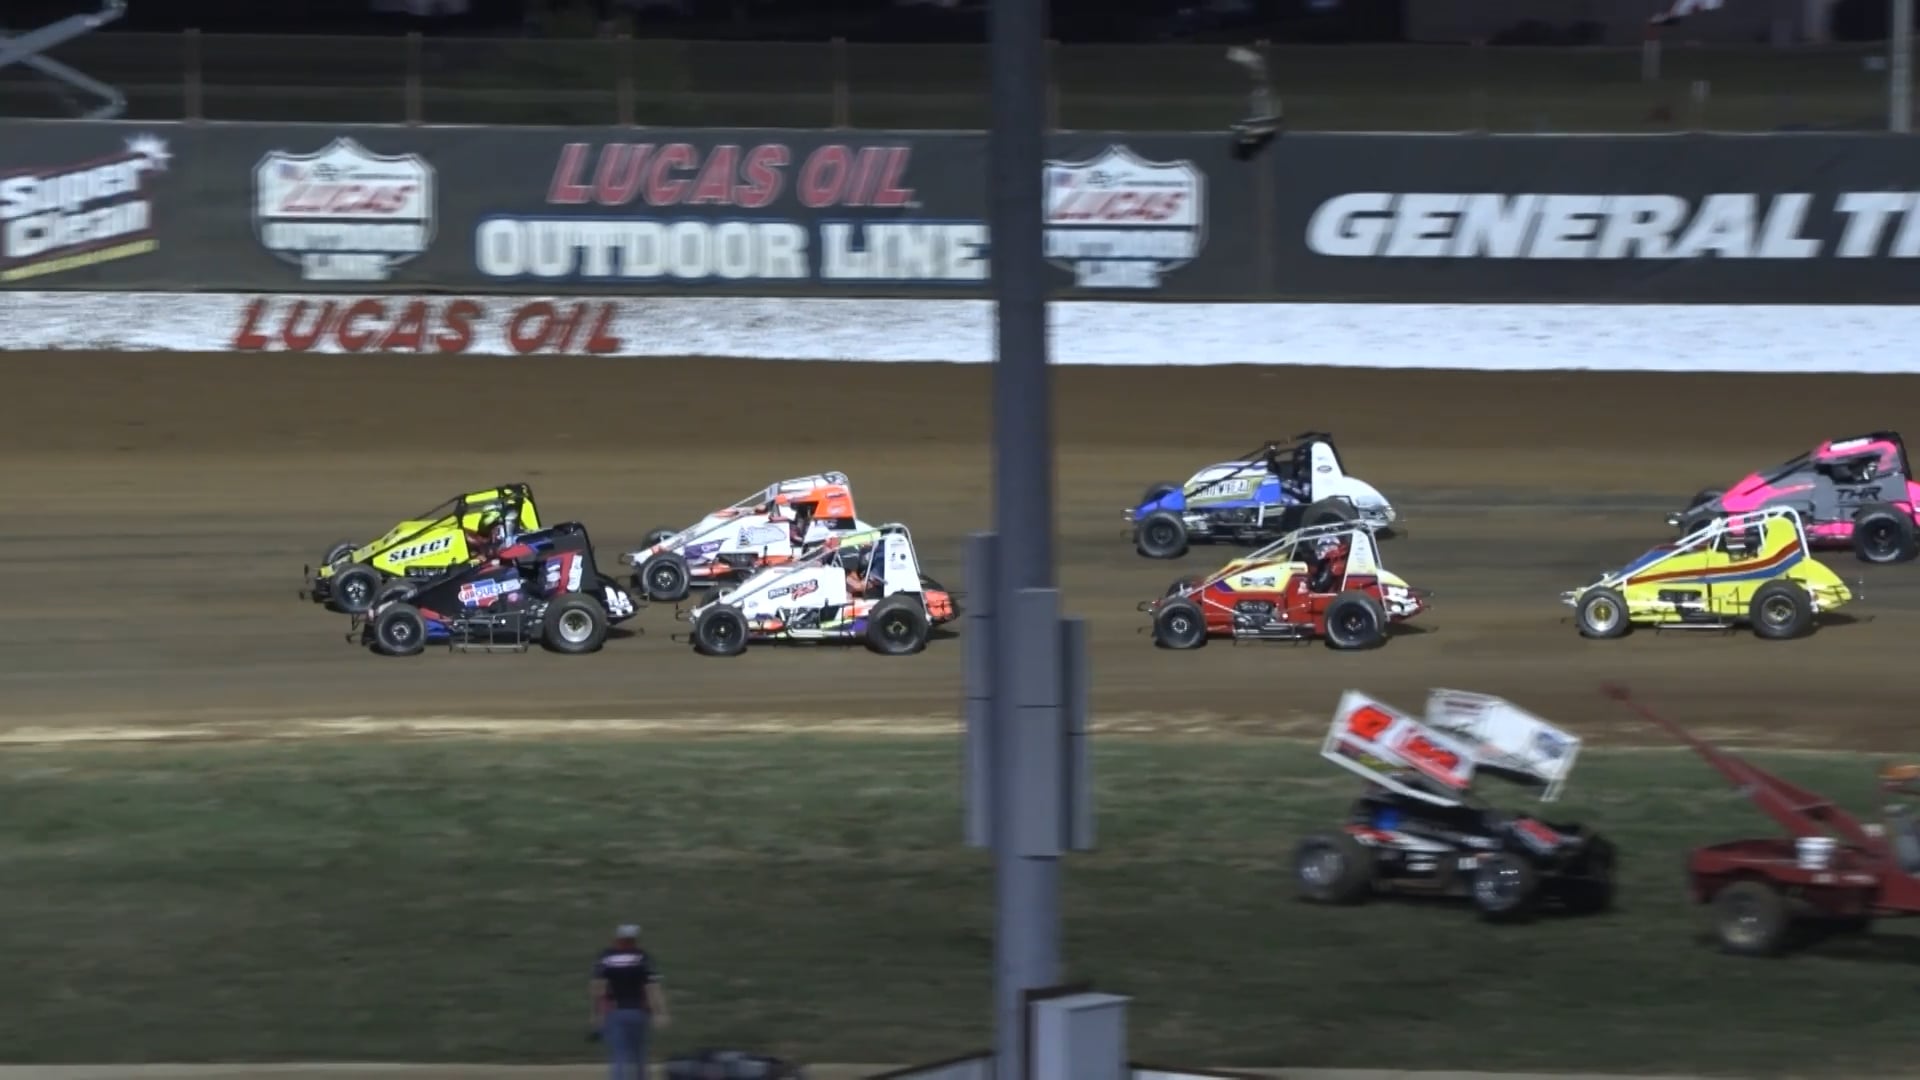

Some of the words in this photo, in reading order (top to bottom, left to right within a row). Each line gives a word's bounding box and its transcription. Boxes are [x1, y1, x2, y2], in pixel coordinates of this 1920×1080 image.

[546, 143, 790, 207] LUCAS
[797, 145, 916, 208] OIL
[476, 218, 810, 279] OUTDOOR
[819, 223, 990, 281] LINE
[1306, 193, 1824, 259] GENERAL
[233, 300, 484, 352] LUCAS
[508, 300, 626, 353] OIL
[388, 535, 452, 563] SELECT
